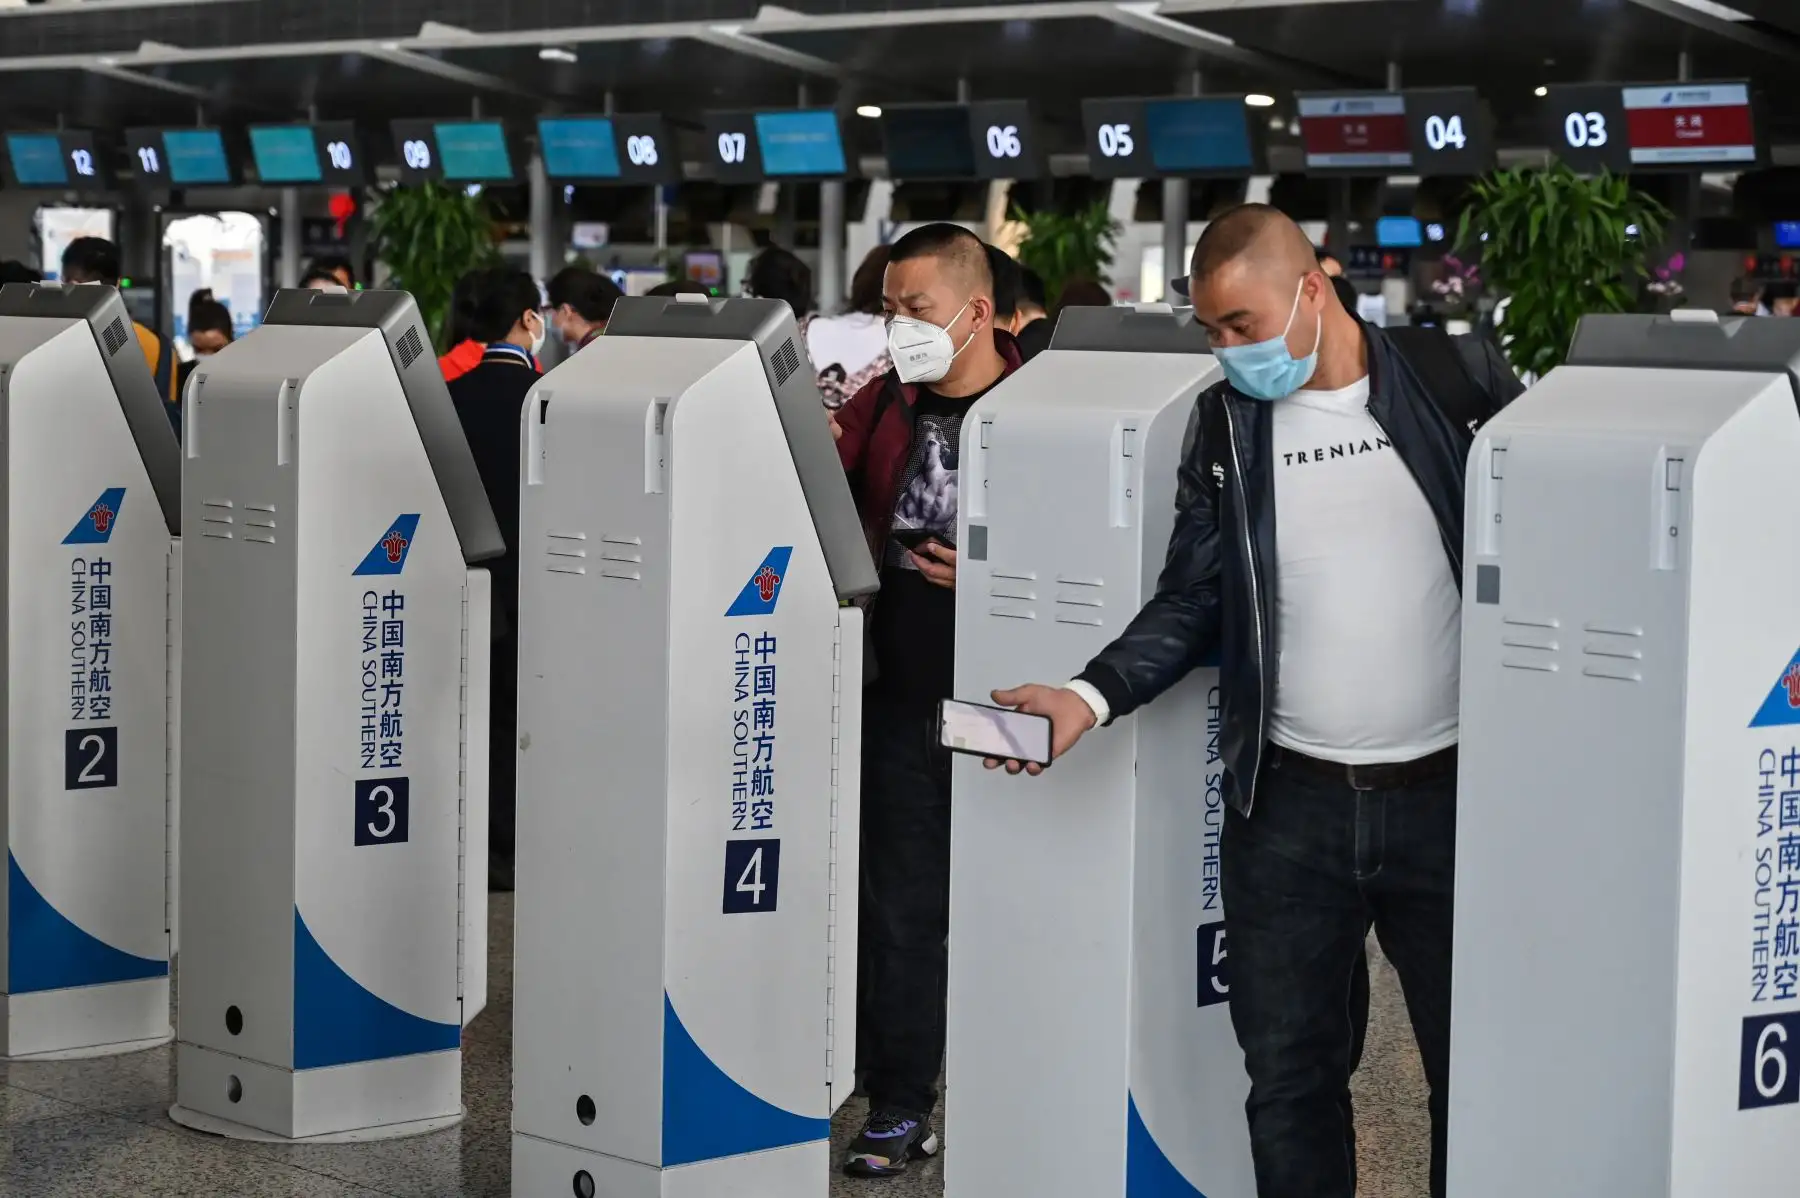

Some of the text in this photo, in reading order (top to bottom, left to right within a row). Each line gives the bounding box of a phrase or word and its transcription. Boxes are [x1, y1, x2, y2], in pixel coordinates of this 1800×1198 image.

[327, 141, 351, 169] 10
[404, 140, 430, 169] 09
[627, 135, 657, 165] 08
[718, 132, 746, 163] 07
[987, 125, 1021, 158] 06
[1098, 124, 1134, 157] 05
[1425, 115, 1466, 150] 04
[1565, 111, 1607, 147] 03
[71, 149, 94, 175] 12
[138, 147, 159, 172] 11
[71, 557, 86, 720] CHINA SOUTHERN
[89, 557, 111, 720] 中国南方航空
[361, 591, 377, 769] CHINA SOUTHERN
[380, 590, 404, 769] 中国南方航空
[732, 632, 750, 831] CHINA SOUTHERN
[751, 631, 776, 830] 中国南方航空
[77, 734, 106, 783] 2
[367, 785, 396, 838] 3
[1202, 772, 1221, 911] SOUTHERN
[735, 847, 766, 905] 4
[1751, 748, 1776, 1001] CHINA SOUTHERN
[1210, 929, 1230, 994] 5
[1754, 1022, 1788, 1099] 6
